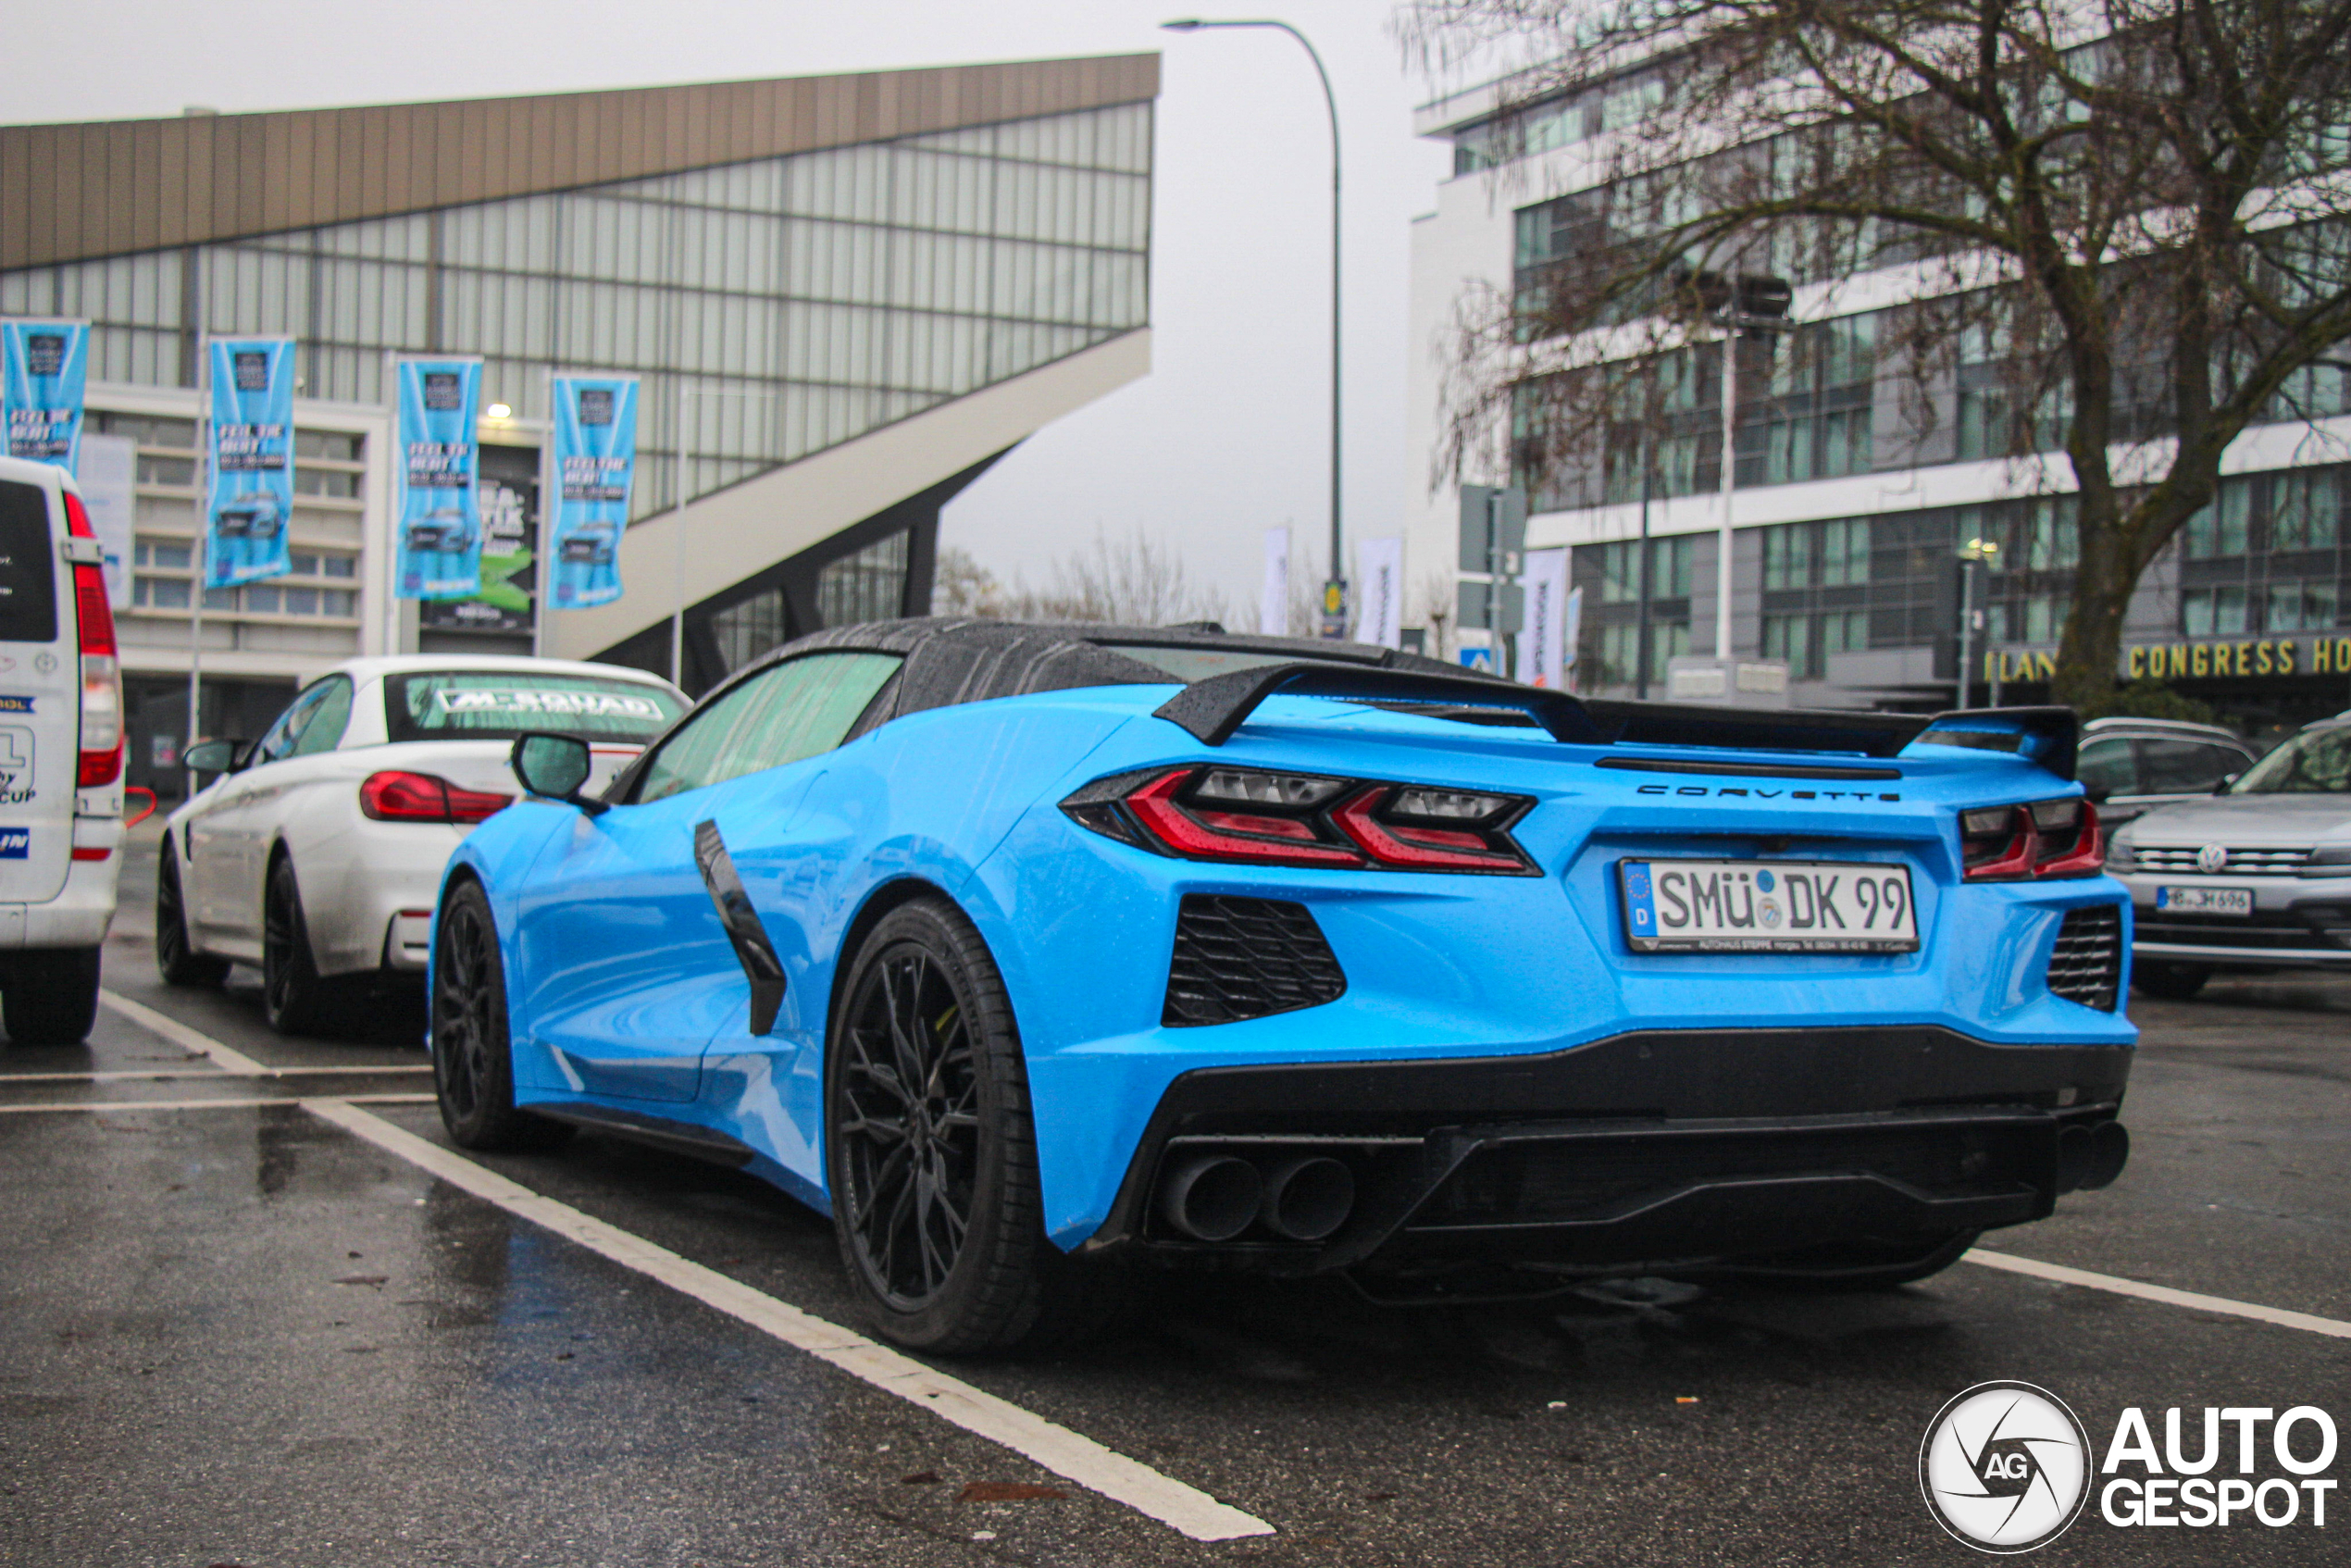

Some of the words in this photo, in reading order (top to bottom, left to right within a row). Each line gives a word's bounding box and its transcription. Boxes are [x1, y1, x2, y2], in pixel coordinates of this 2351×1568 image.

[2130, 639, 2294, 678] CONGRESS
[1636, 784, 1900, 803] CORVETTE
[1660, 872, 1756, 928] SMÜ
[1784, 873, 1847, 929] DK
[1855, 876, 1906, 929] 99
[1635, 908, 1648, 926] D
